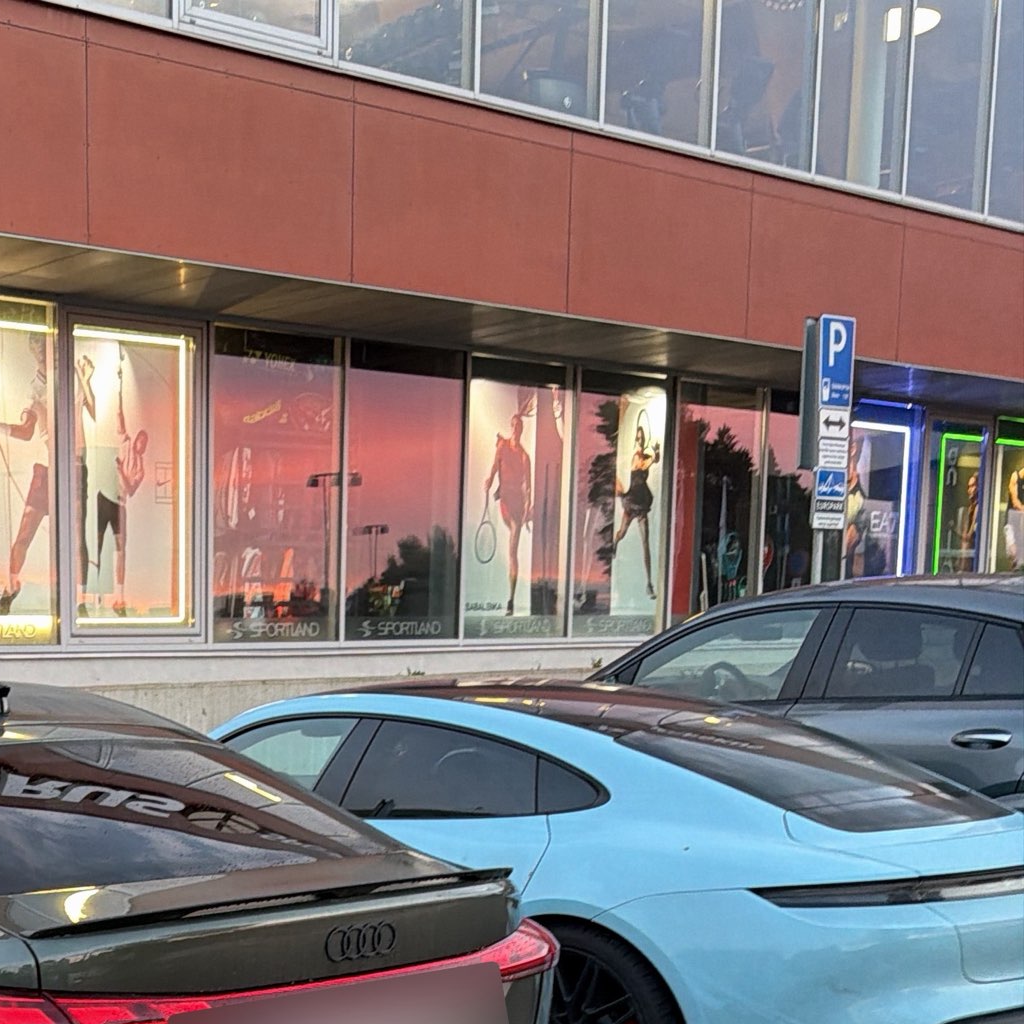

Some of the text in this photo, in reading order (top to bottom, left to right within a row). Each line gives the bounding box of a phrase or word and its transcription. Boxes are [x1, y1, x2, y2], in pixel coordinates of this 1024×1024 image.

[828, 321, 847, 367] P
[249, 621, 320, 638] SPORTLAND
[377, 620, 442, 636] SPORTLAND
